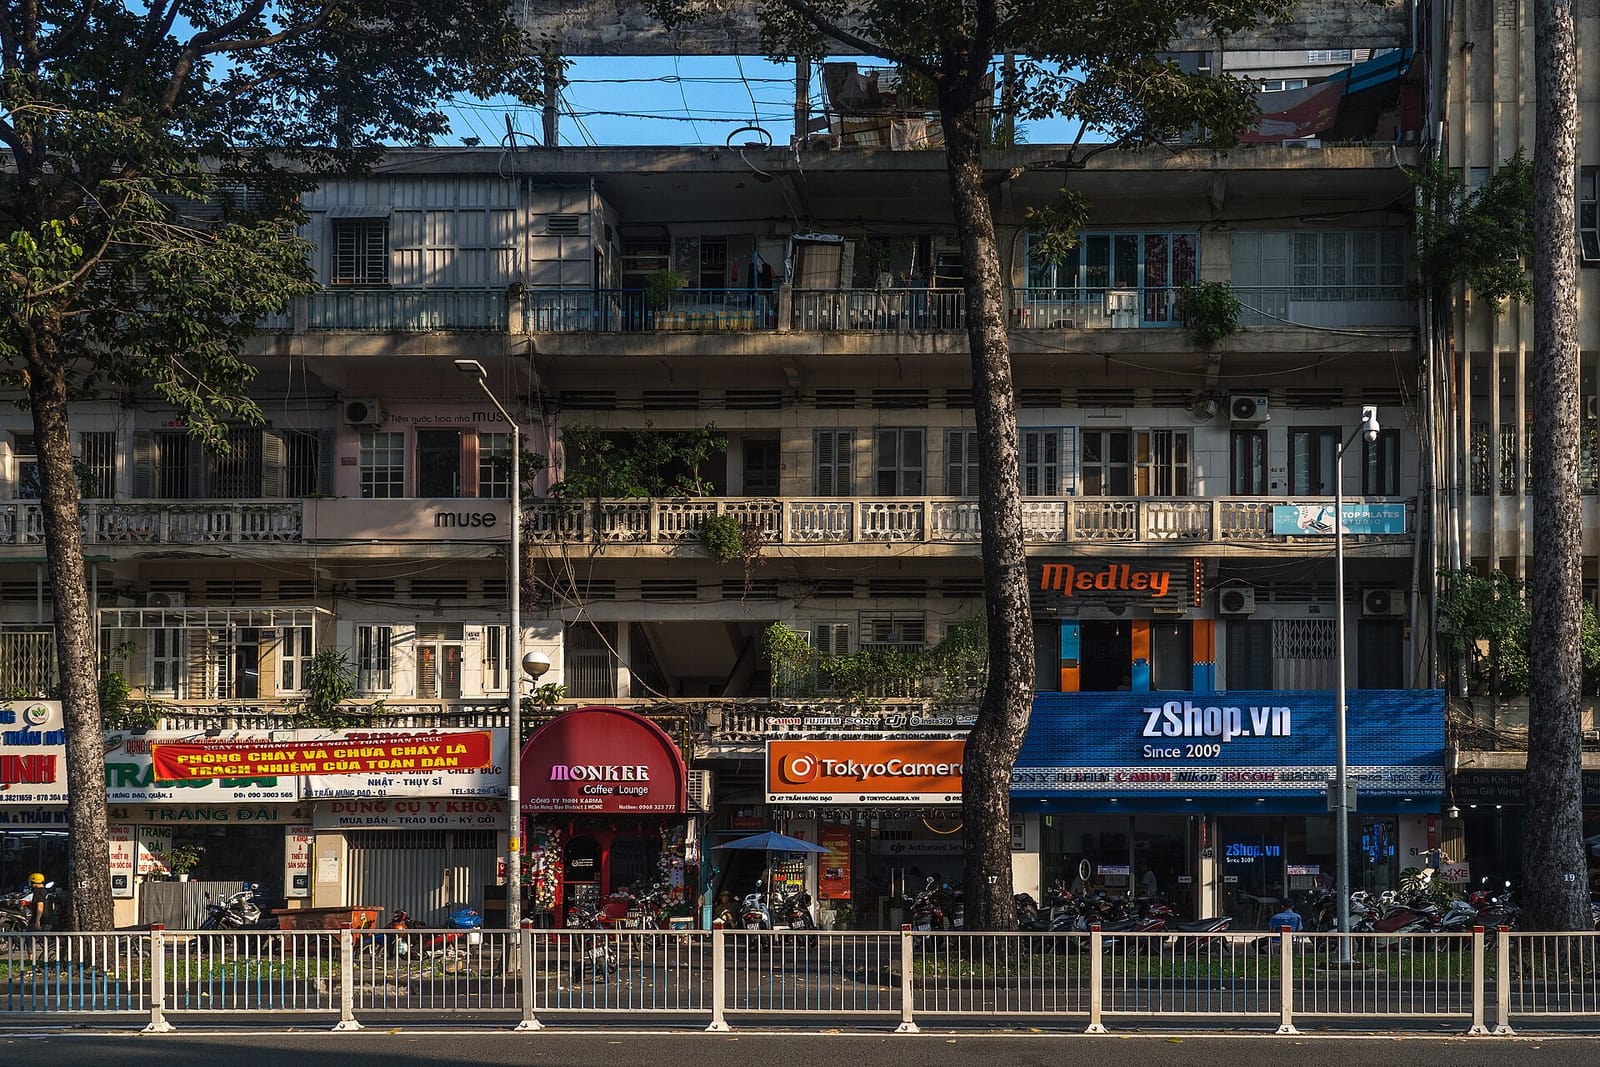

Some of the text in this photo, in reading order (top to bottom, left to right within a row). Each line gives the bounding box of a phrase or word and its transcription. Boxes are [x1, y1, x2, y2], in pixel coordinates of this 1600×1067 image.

[435, 415, 452, 423] hoa
[434, 512, 496, 528] muse
[1040, 564, 1170, 597] Medley
[766, 716, 802, 726] Canon
[804, 717, 842, 726] FUJIFILM
[844, 717, 882, 726] SONY
[1143, 700, 1291, 742] zShop.vn
[178, 744, 468, 764] PHÒNG CHÁY VÀ CHỮA CHÁY LÀ
[1144, 744, 1220, 758] Since 2009
[256, 762, 316, 774] NHIỆM
[322, 759, 360, 772] CỦA
[366, 758, 414, 769] TOÀN
[421, 756, 458, 768] DÂN
[550, 764, 650, 781] MONKEE
[1178, 772, 1218, 782] Nikon
[1224, 772, 1275, 782] RICOH
[368, 778, 394, 788] NHẬT
[403, 778, 430, 788] THỤY
[584, 784, 649, 796] Coffee Lounge
[330, 800, 502, 815] DỤNG CỤ Y KHOA
[144, 808, 229, 820] TRANG
[366, 816, 388, 824] BÁN
[140, 826, 171, 838] TRANG
[1226, 844, 1280, 858] zShop.vn
[1454, 868, 1468, 878] XE
[1564, 874, 1576, 882] 19
[78, 880, 88, 888] 15
[988, 876, 998, 884] 17
